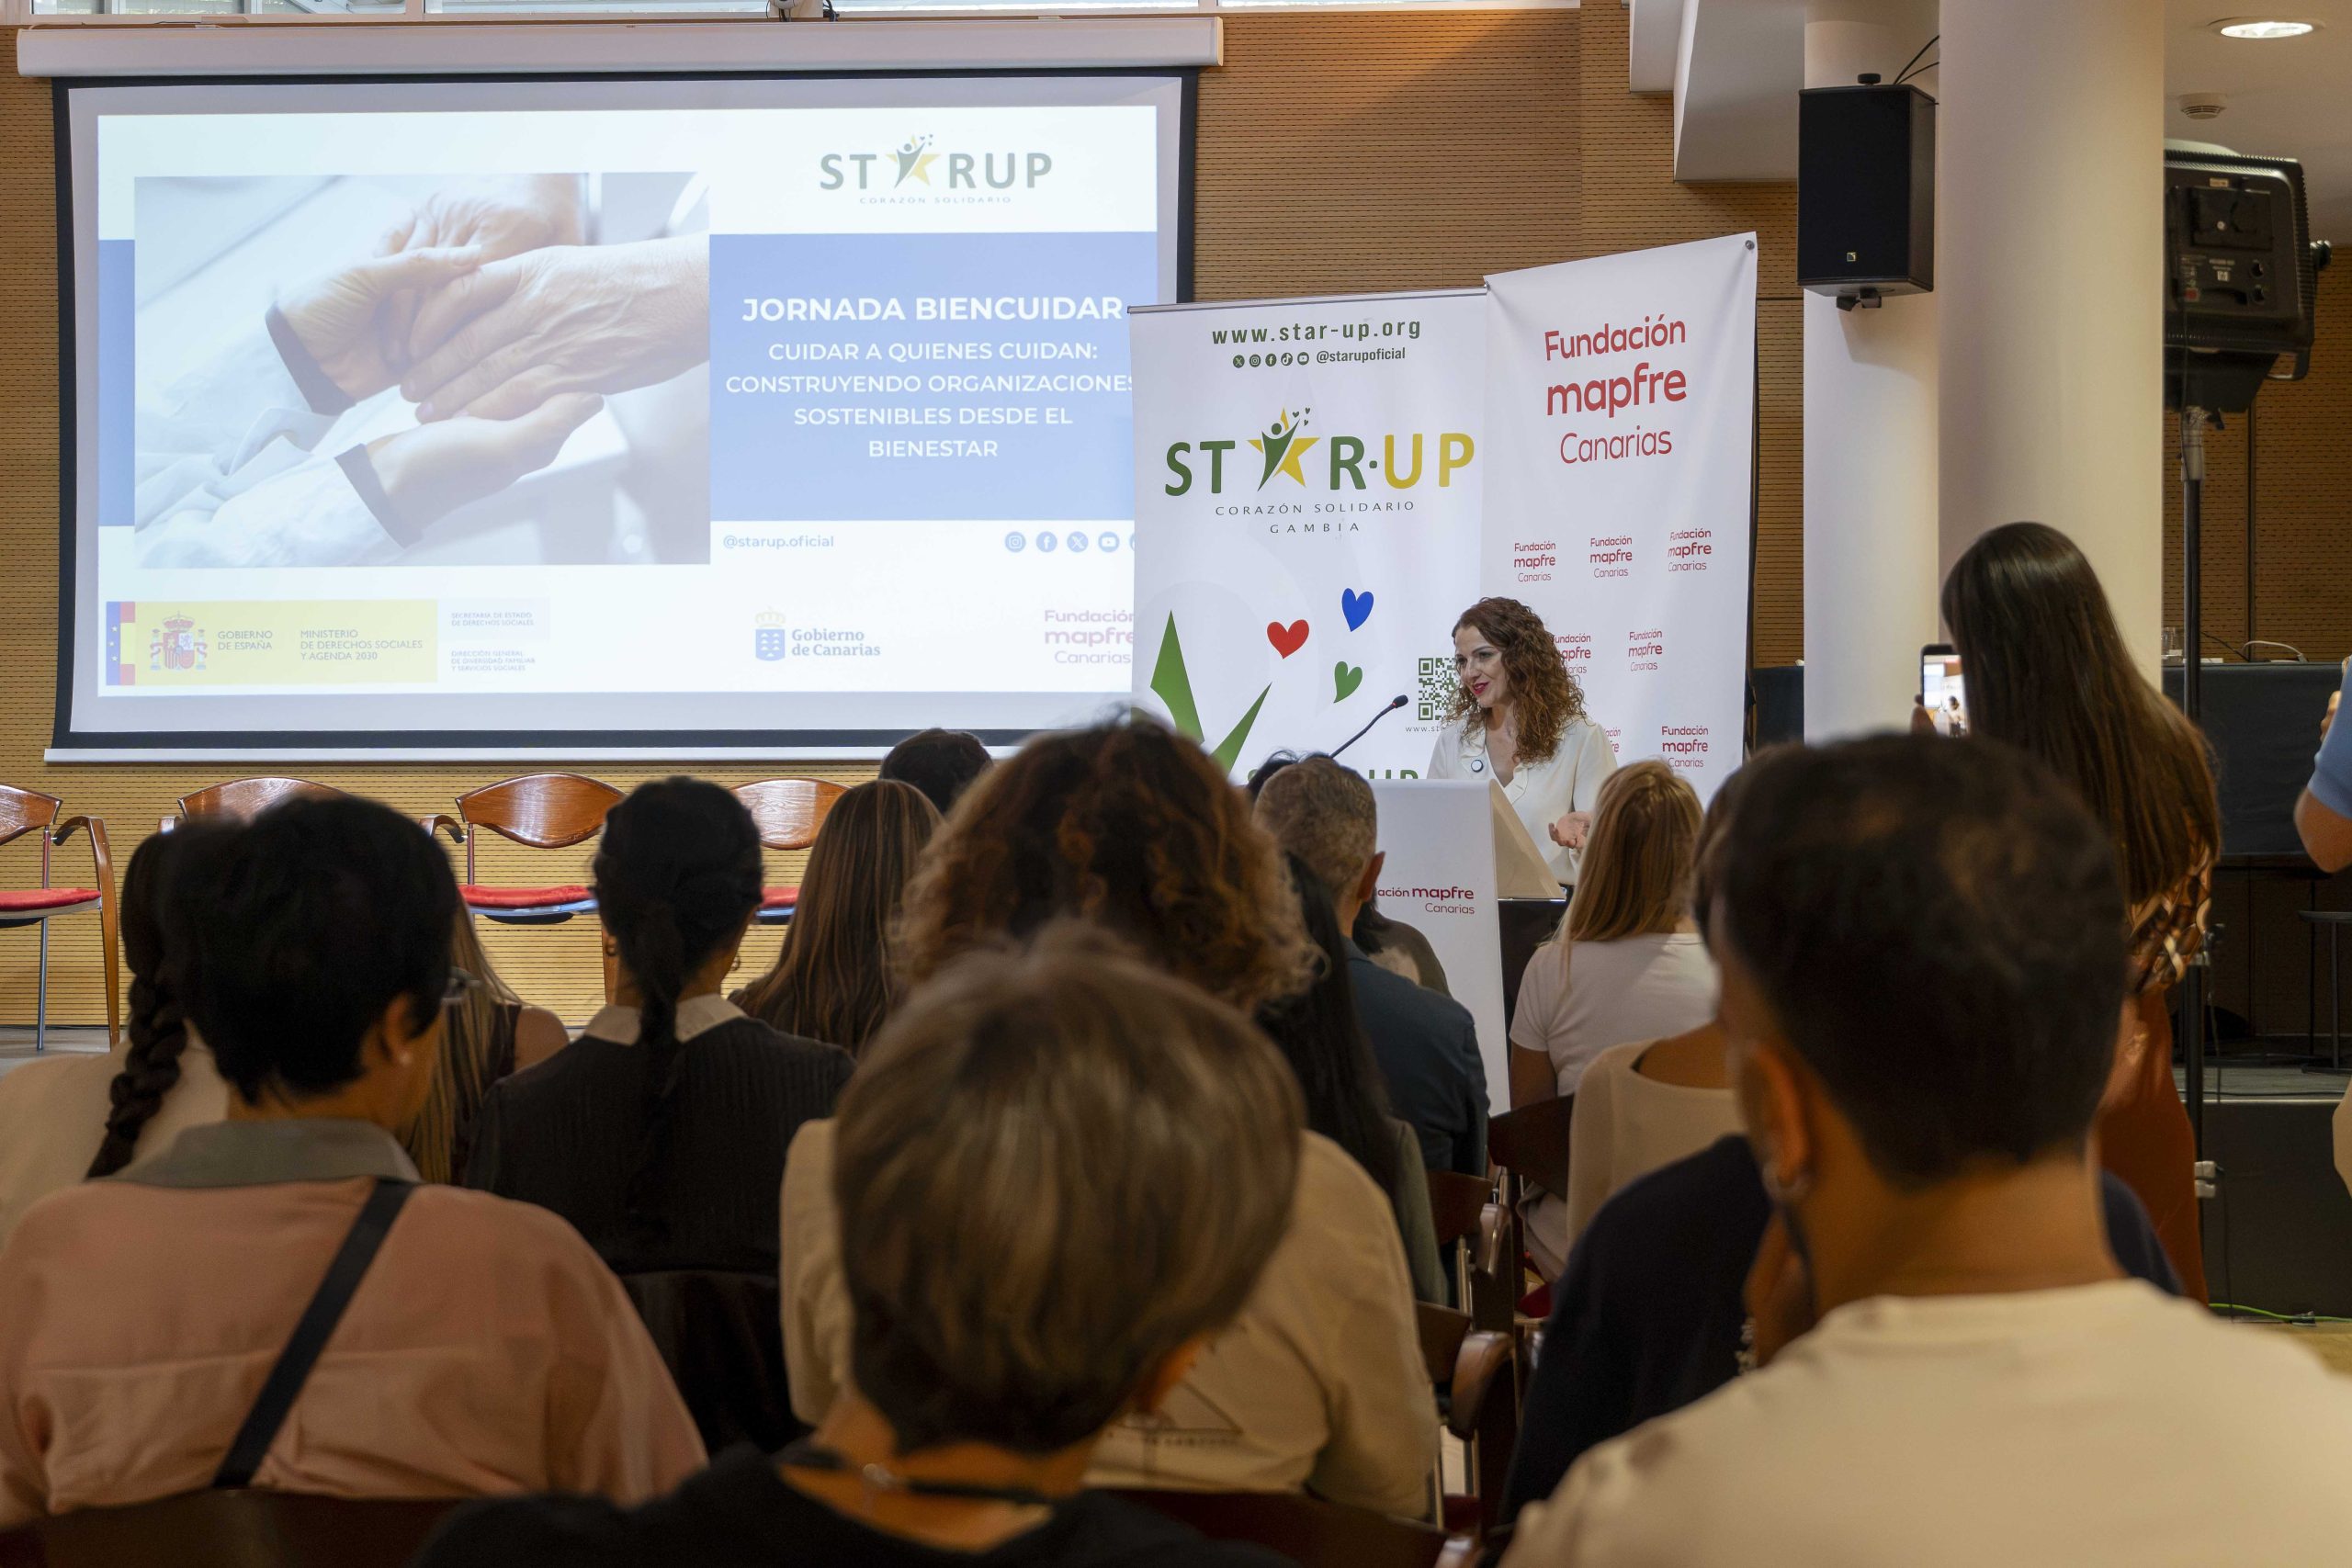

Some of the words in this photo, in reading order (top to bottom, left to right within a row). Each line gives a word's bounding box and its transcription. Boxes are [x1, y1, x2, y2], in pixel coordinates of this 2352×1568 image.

[742, 298, 905, 321] JORNADA
[917, 297, 1122, 321] BIENCUIDAR
[1212, 319, 1421, 344] www.star-up.org
[1544, 314, 1686, 360] Fundación
[769, 343, 858, 361] CUIDAR
[865, 344, 882, 360] A
[888, 343, 992, 363] QUIENES
[999, 342, 1098, 360] CUIDAN:
[1316, 347, 1406, 365] @starupoficial
[726, 376, 921, 393] CONSTRUYENDO
[1547, 362, 1687, 418] mapfre
[794, 407, 952, 425] SOSTENIBLES
[959, 407, 1037, 424] DESDE
[1046, 407, 1073, 424] EL
[869, 439, 998, 457] BIENESTAR
[1560, 425, 1672, 464] Canarias
[1216, 502, 1302, 516] CORAZÓN
[1314, 501, 1415, 513] SOLIDARIO
[1270, 523, 1360, 534] GAMBIA
[1669, 528, 1712, 541] Fundación
[723, 535, 834, 549] @starup.oficial
[1514, 540, 1556, 551] Fundación
[1590, 536, 1633, 547] Fundación
[1590, 548, 1633, 565] mapfre
[1668, 542, 1712, 558] mapfre
[1514, 554, 1555, 570] mapfre
[1668, 560, 1707, 572] Canarias
[1518, 572, 1551, 582] Canarias
[1593, 567, 1628, 578] Canarias
[218, 631, 273, 639] GOBIERNO
[300, 629, 359, 638] MINISTERIO
[791, 627, 865, 642] Gobierno
[1555, 633, 1591, 643] undación
[218, 642, 231, 650] DE
[234, 640, 273, 649] ESPAÑA
[317, 640, 372, 649] DERECHOS
[374, 640, 424, 649] SOCIALES
[791, 642, 809, 657] de
[812, 642, 881, 657] Canarias
[1628, 642, 1663, 658] mapfre
[300, 652, 308, 660] Y
[309, 652, 352, 660] AGENDA
[355, 651, 378, 660] 2030
[1054, 650, 1132, 664] Canarias
[1559, 647, 1591, 661] apfre
[1661, 726, 1709, 735] Fundación
[1662, 739, 1709, 754] mapfre
[1668, 757, 1704, 767] Canarias
[1378, 887, 1409, 897] ación
[1412, 886, 1474, 900] mapfre
[1425, 903, 1475, 914] Canarias
